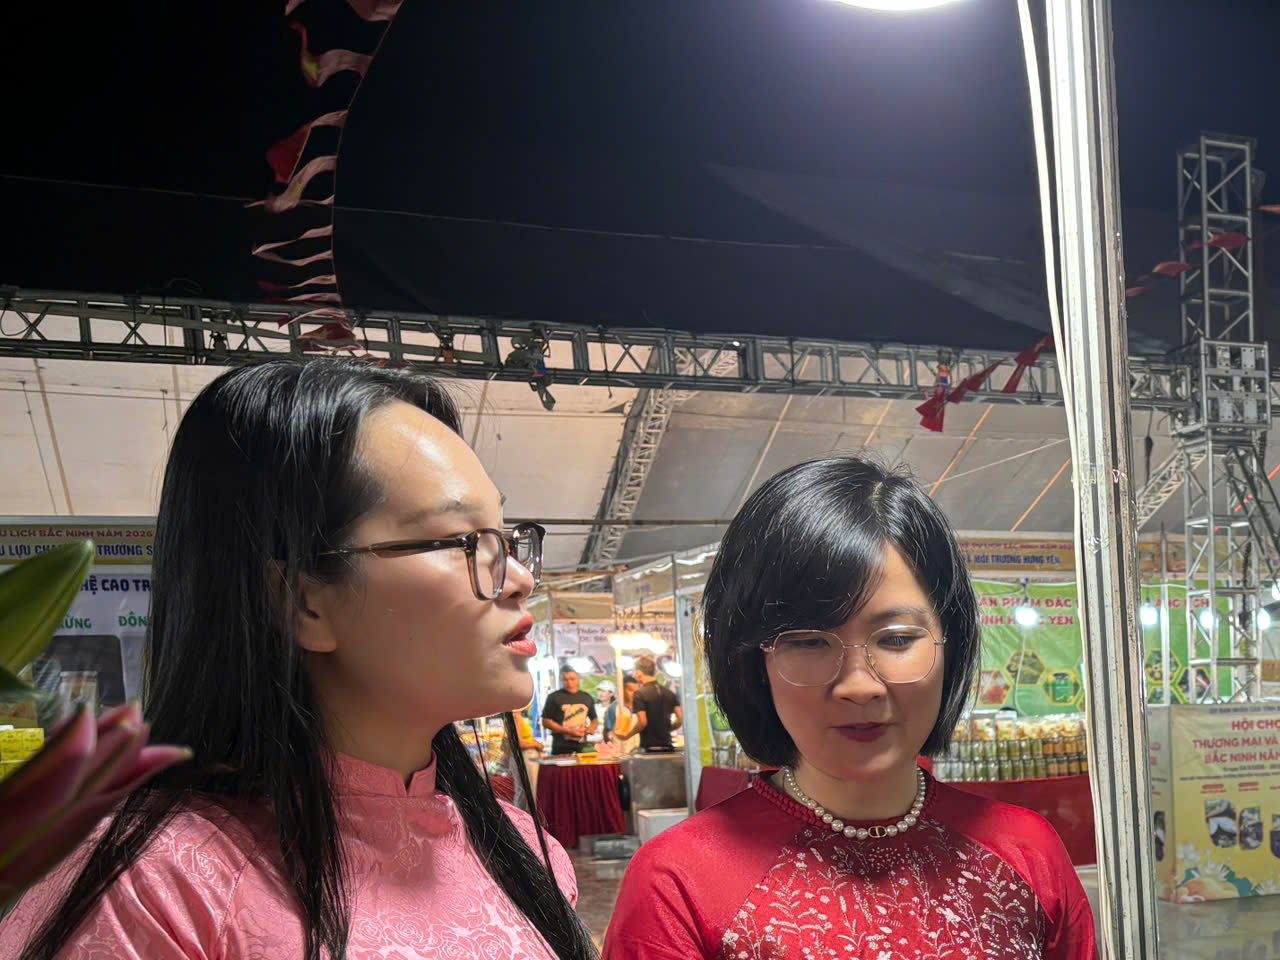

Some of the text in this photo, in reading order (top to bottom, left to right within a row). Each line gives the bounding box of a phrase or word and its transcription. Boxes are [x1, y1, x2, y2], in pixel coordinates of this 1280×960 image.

[66, 529, 93, 538] NINH
[101, 578, 129, 592] CAO
[1230, 752, 1257, 763] NINH
